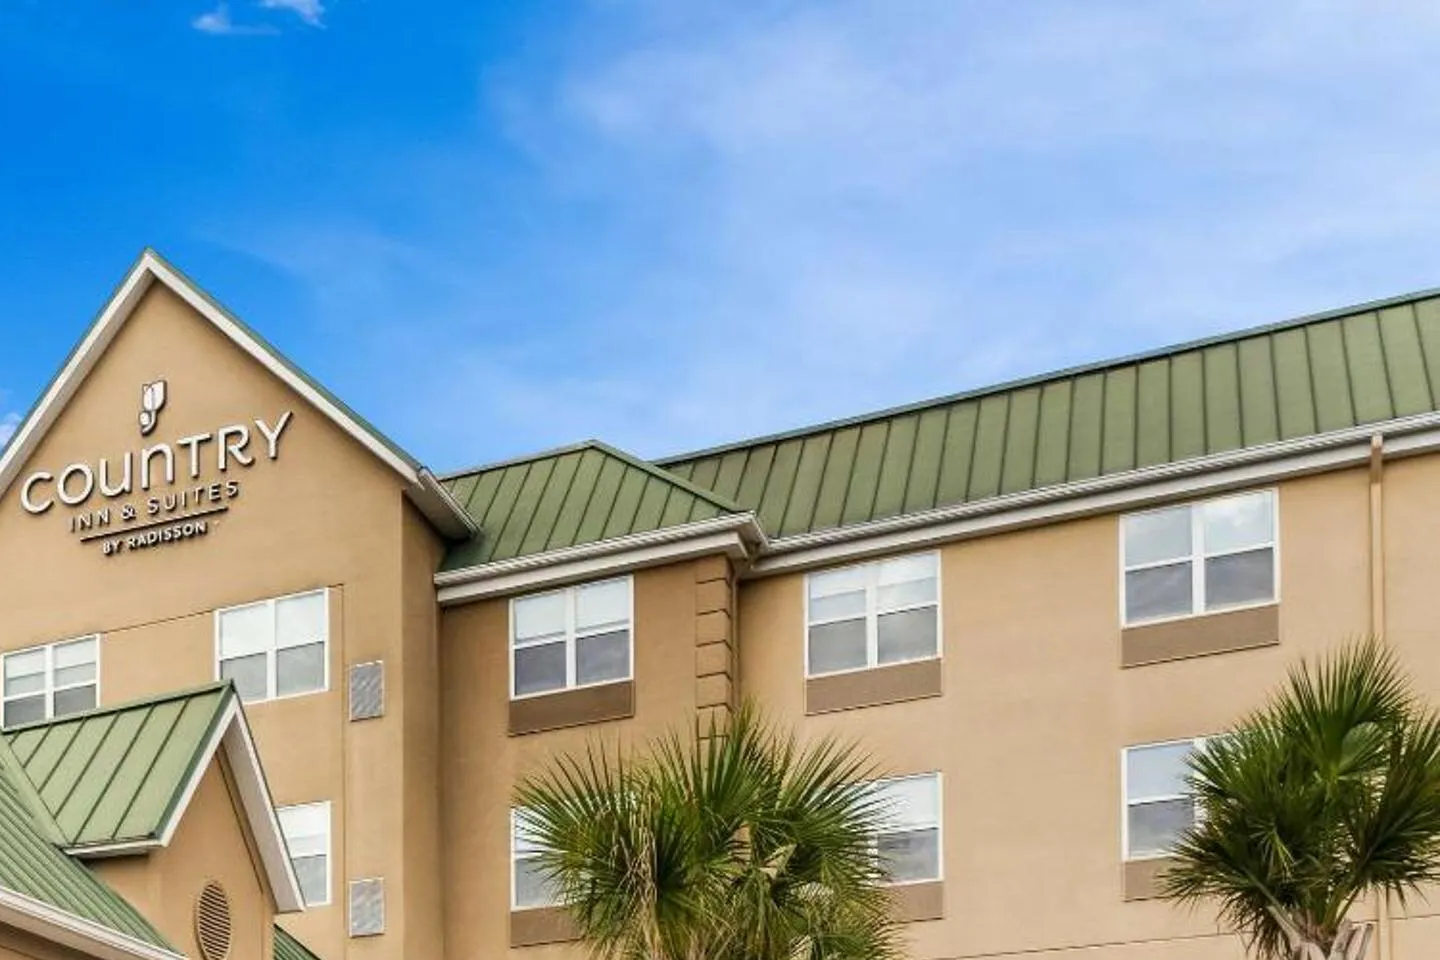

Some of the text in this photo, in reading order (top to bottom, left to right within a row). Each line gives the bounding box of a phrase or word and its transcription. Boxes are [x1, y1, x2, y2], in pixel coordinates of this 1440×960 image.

[69, 481, 239, 533] INN & SUITES
[103, 521, 208, 556] BY RADISSON
